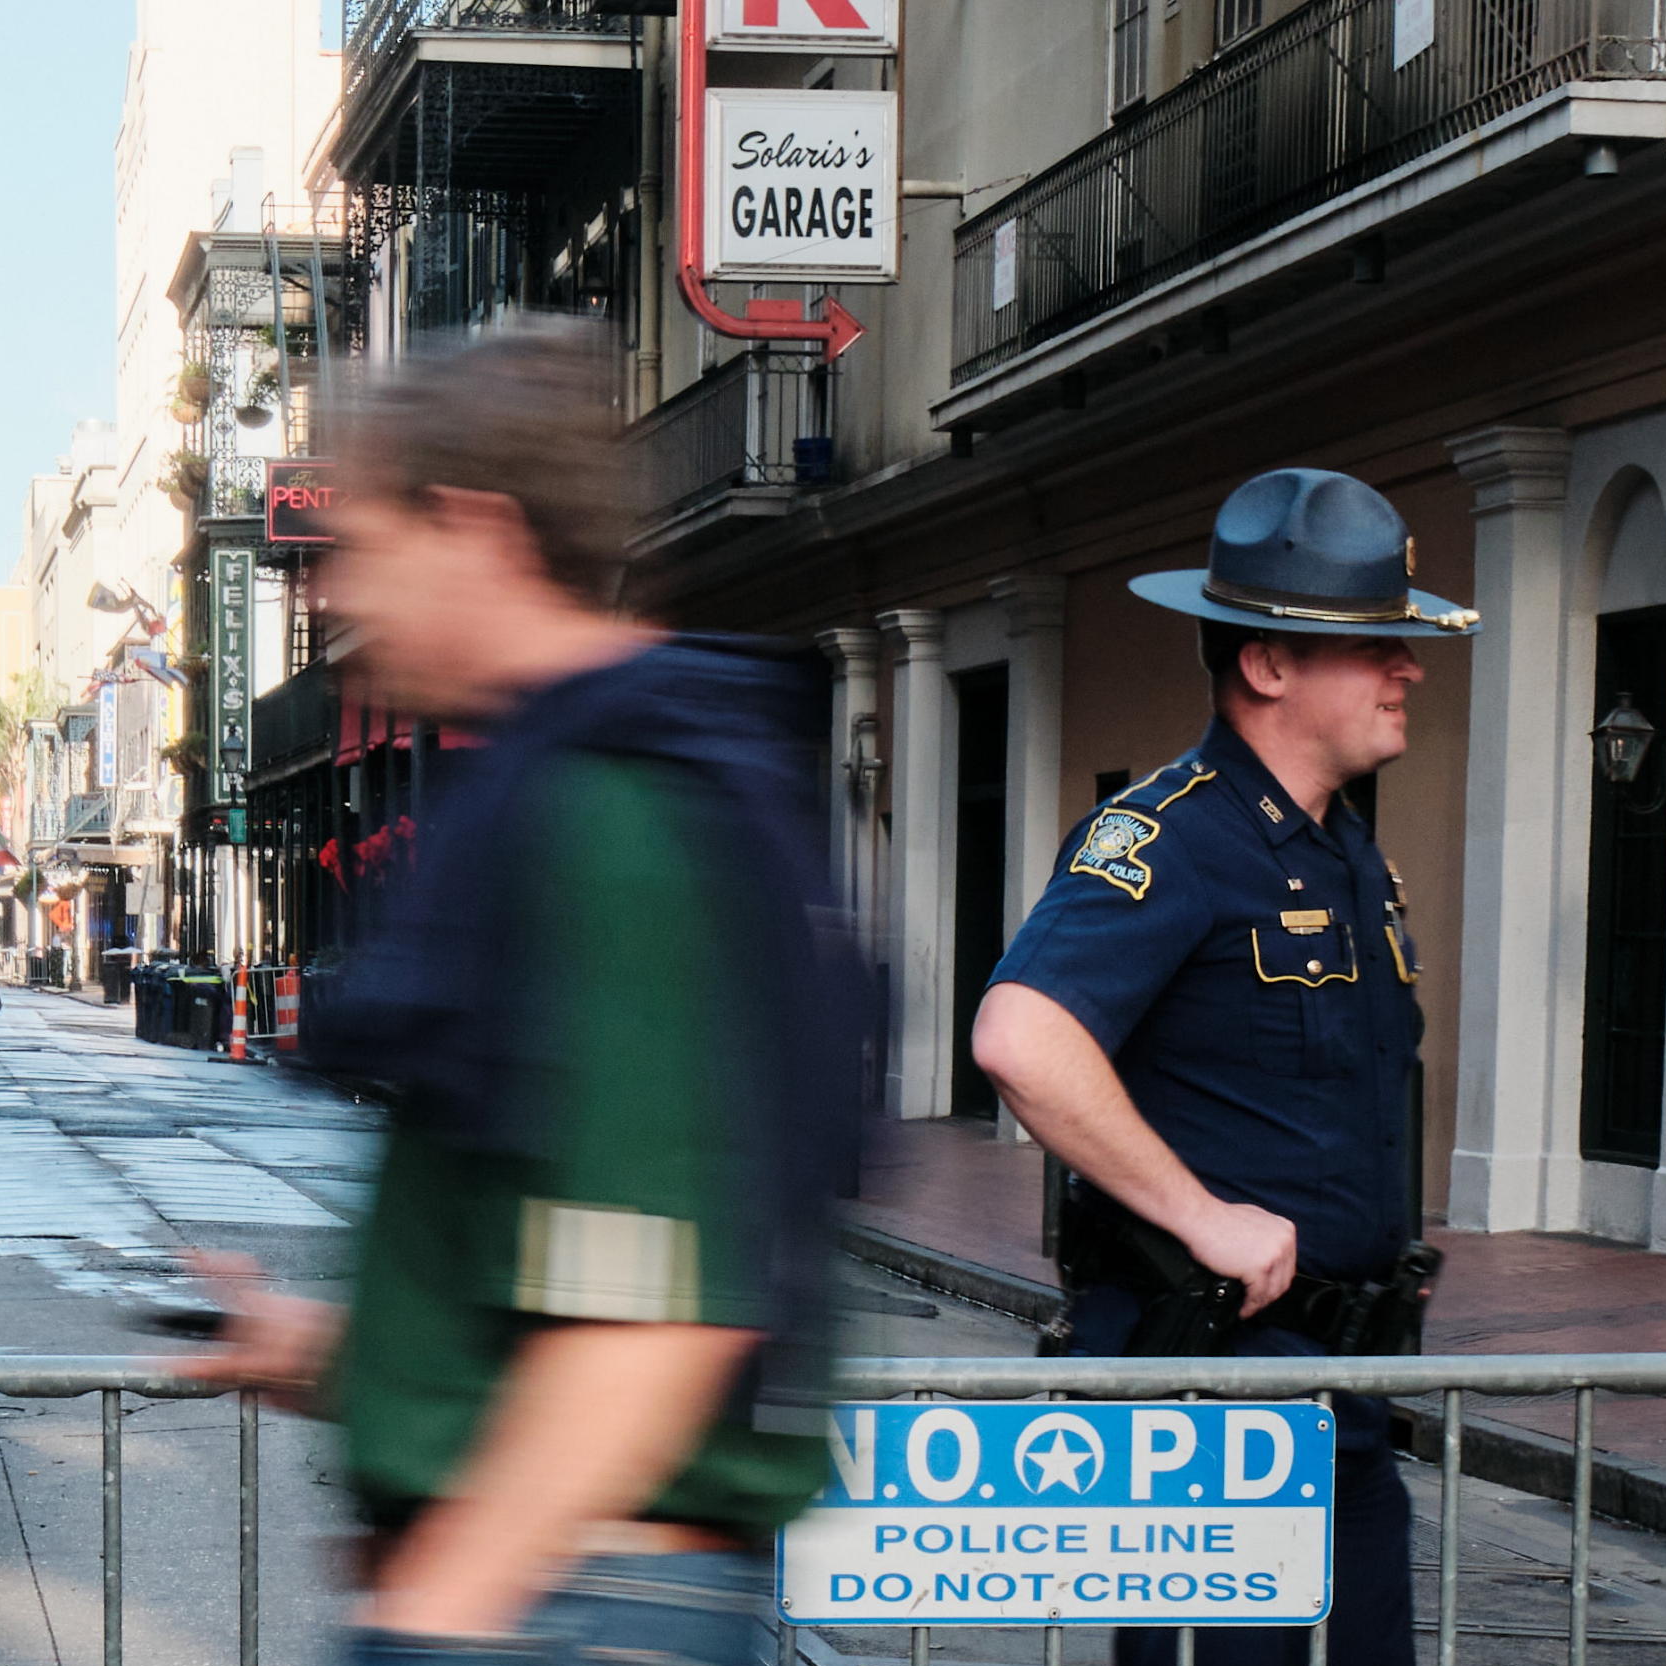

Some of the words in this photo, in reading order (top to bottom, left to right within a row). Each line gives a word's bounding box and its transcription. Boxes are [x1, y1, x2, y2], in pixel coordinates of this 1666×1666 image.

[731, 129, 875, 171] Solaris's
[731, 185, 874, 240] GARAGE
[272, 486, 336, 509] PENT
[222, 563, 244, 710] FELIX'S
[1098, 813, 1150, 842] LOUISIANA
[1079, 848, 1106, 869] STATE
[1106, 862, 1146, 883] POLICE
[820, 1408, 995, 1503] N.O.
[1130, 1408, 1318, 1503] P.D.
[874, 1524, 1089, 1554] POLICE
[1109, 1524, 1235, 1553] LINE
[829, 1572, 912, 1603] DO
[934, 1572, 1054, 1603] NOT
[1073, 1572, 1279, 1603] CROSS
